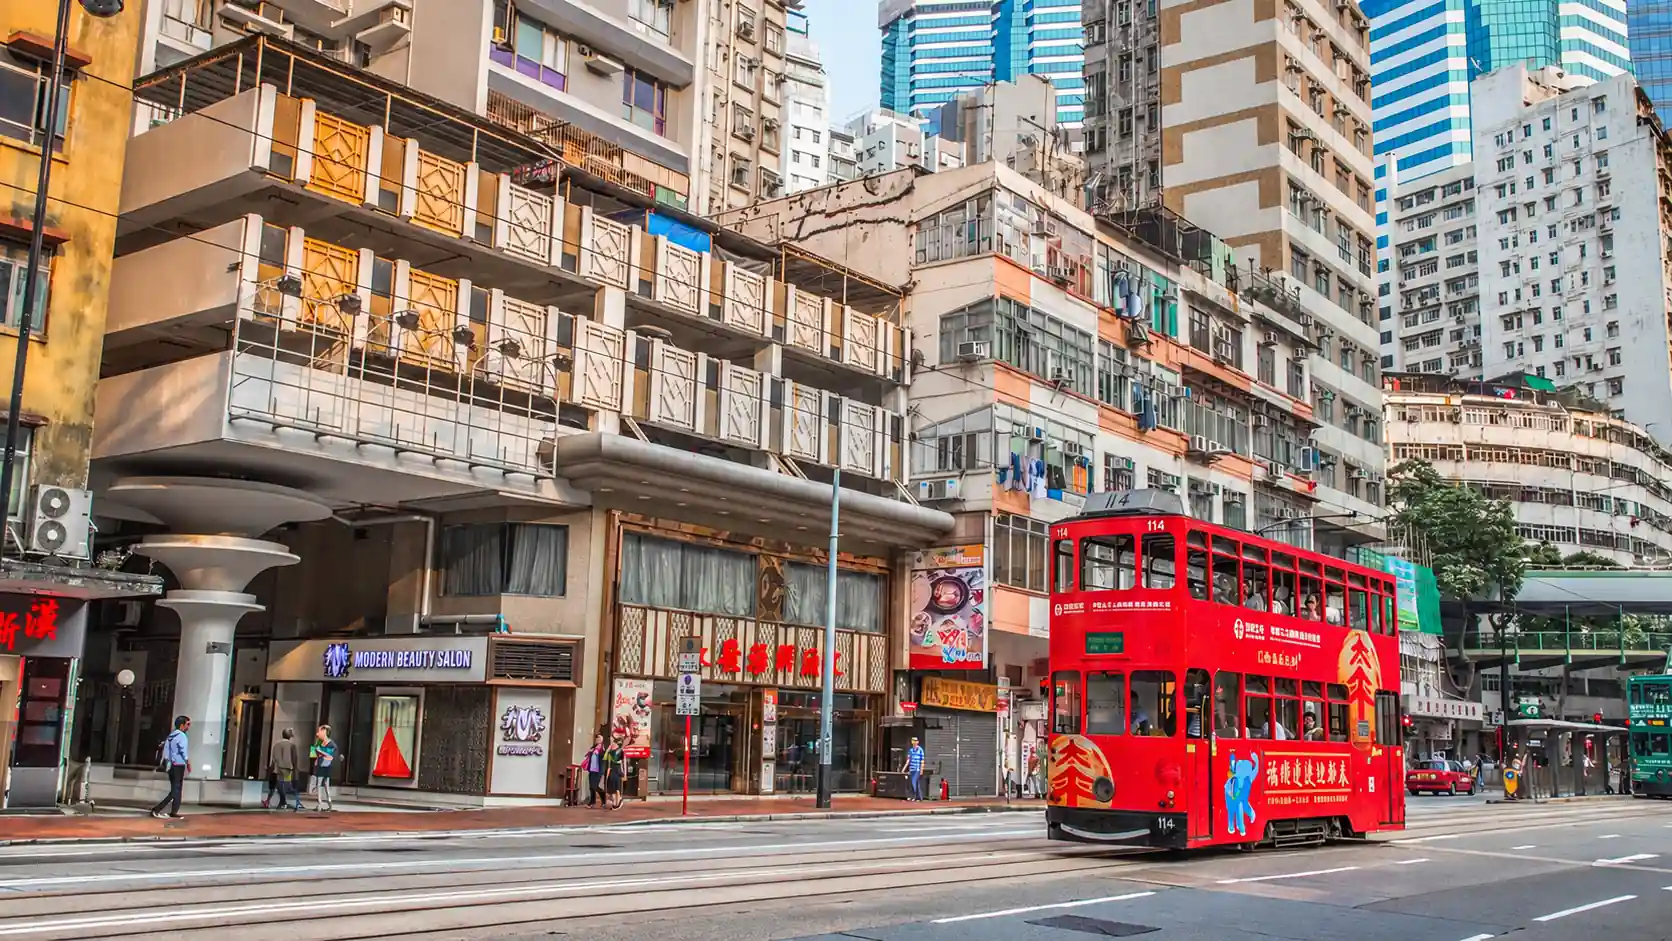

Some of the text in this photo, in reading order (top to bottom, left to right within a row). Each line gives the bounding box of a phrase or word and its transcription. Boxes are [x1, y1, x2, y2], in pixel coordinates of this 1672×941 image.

[1105, 493, 1130, 508] 114
[1147, 520, 1165, 532] 114
[1056, 528, 1068, 537] 114
[354, 650, 472, 668] MODERN BEAUTY SALON
[1158, 817, 1175, 829] 114
